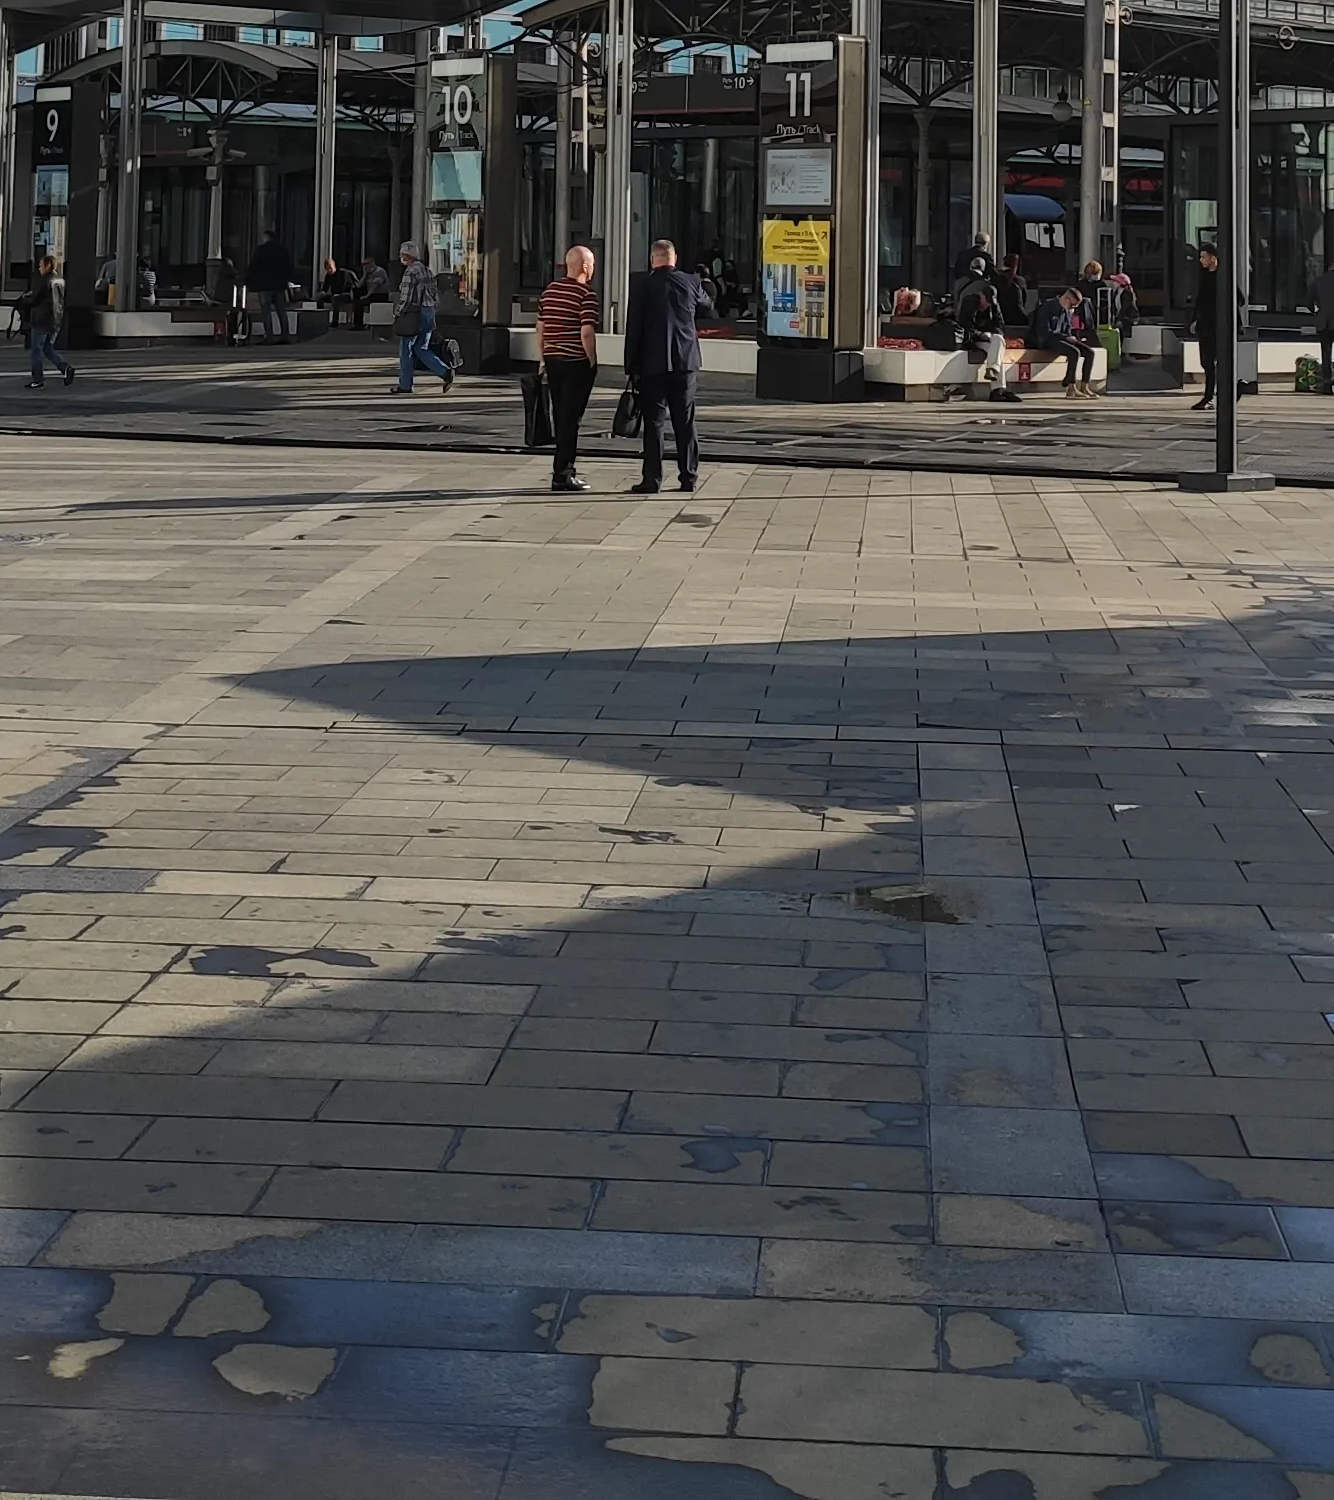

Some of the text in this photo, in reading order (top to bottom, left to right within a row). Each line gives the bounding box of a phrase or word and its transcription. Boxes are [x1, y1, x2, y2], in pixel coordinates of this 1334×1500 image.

[734, 77, 745, 89] 10
[785, 72, 812, 117] 11
[442, 85, 473, 125] 10
[47, 109, 59, 142] 9
[776, 124, 797, 137] Путь
[802, 125, 821, 134] Track
